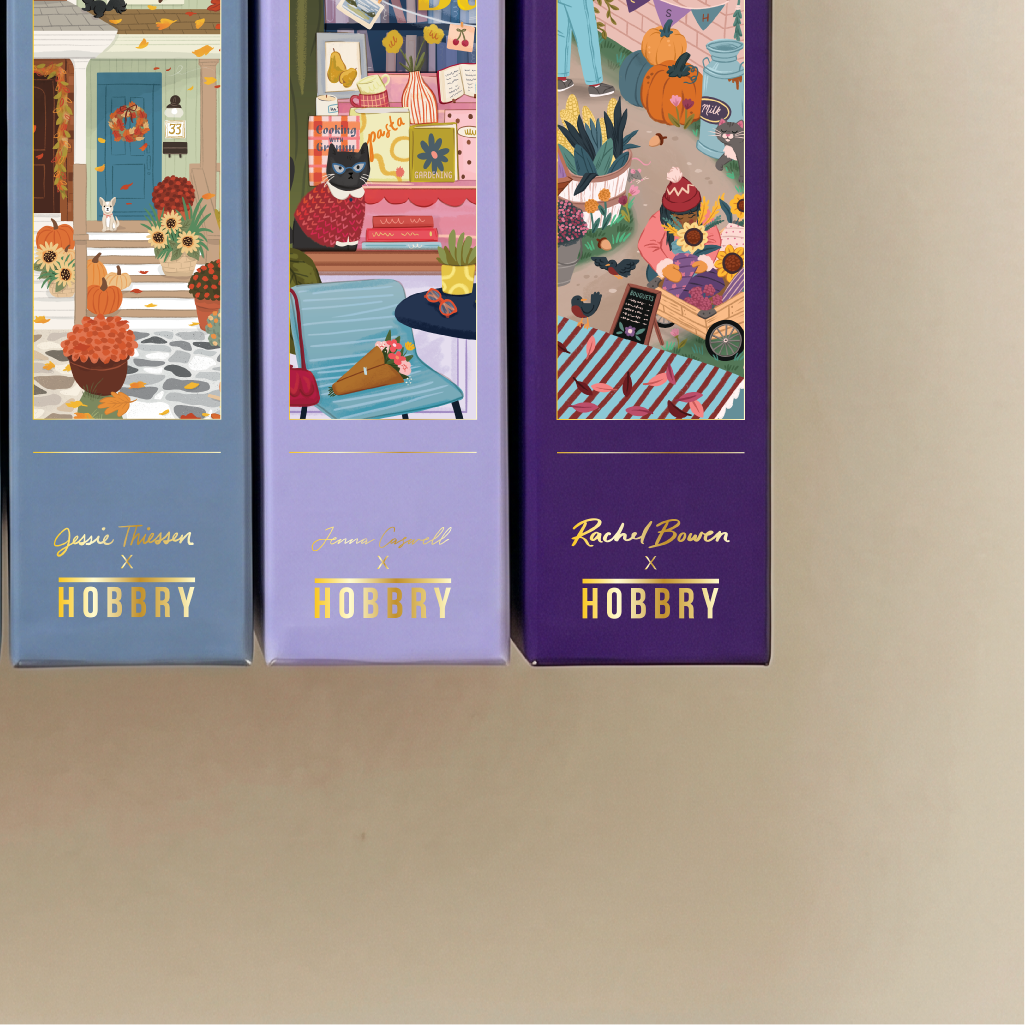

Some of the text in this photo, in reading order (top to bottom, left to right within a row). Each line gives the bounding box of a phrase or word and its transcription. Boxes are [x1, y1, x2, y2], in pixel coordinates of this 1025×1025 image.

[701, 102, 722, 117] Milk
[168, 123, 182, 135] 33
[315, 124, 357, 137] Cooking
[367, 115, 406, 163] pasta
[315, 142, 355, 153] Grnny
[414, 170, 453, 180] GARDENING
[53, 524, 195, 558] Jessie Thiessen
[571, 517, 731, 549] Rachel Bowen
[58, 586, 196, 619] HOBBRY
[314, 586, 452, 620] HOBBRY
[582, 586, 720, 620] HOBBRY
